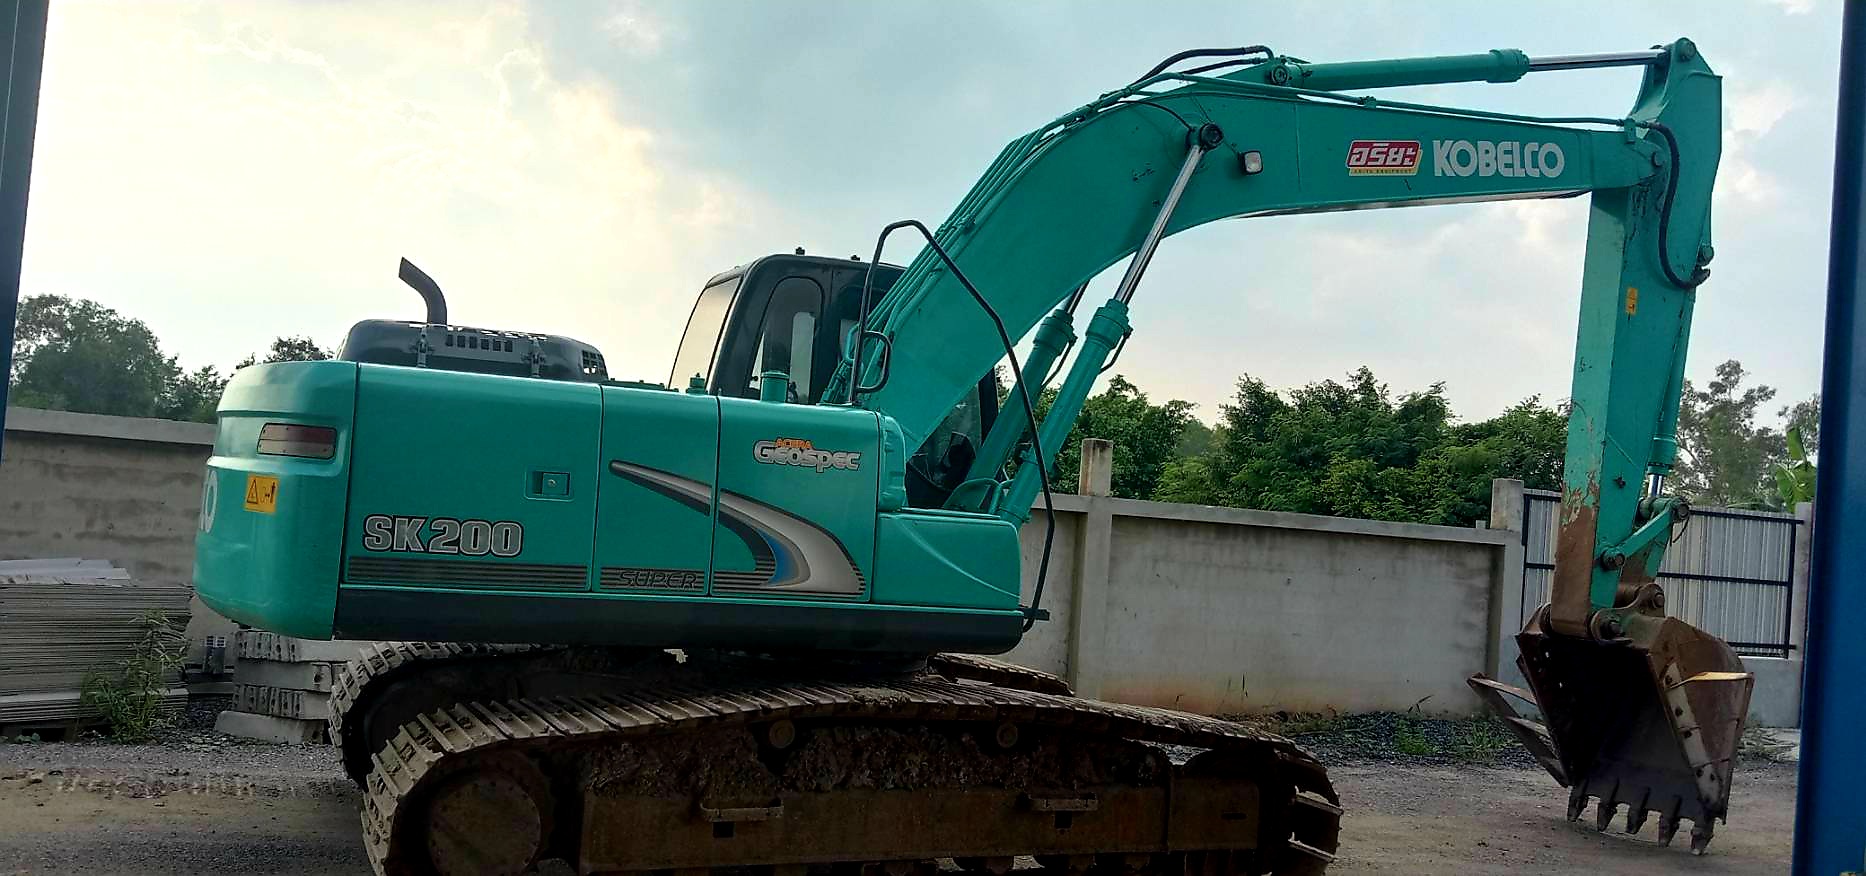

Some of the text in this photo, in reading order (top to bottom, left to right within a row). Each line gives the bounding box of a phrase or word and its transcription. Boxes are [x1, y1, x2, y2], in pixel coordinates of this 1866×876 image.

[1432, 140, 1565, 178] KOBELCO
[363, 514, 524, 557] SK200
[619, 569, 697, 591] SUPER
